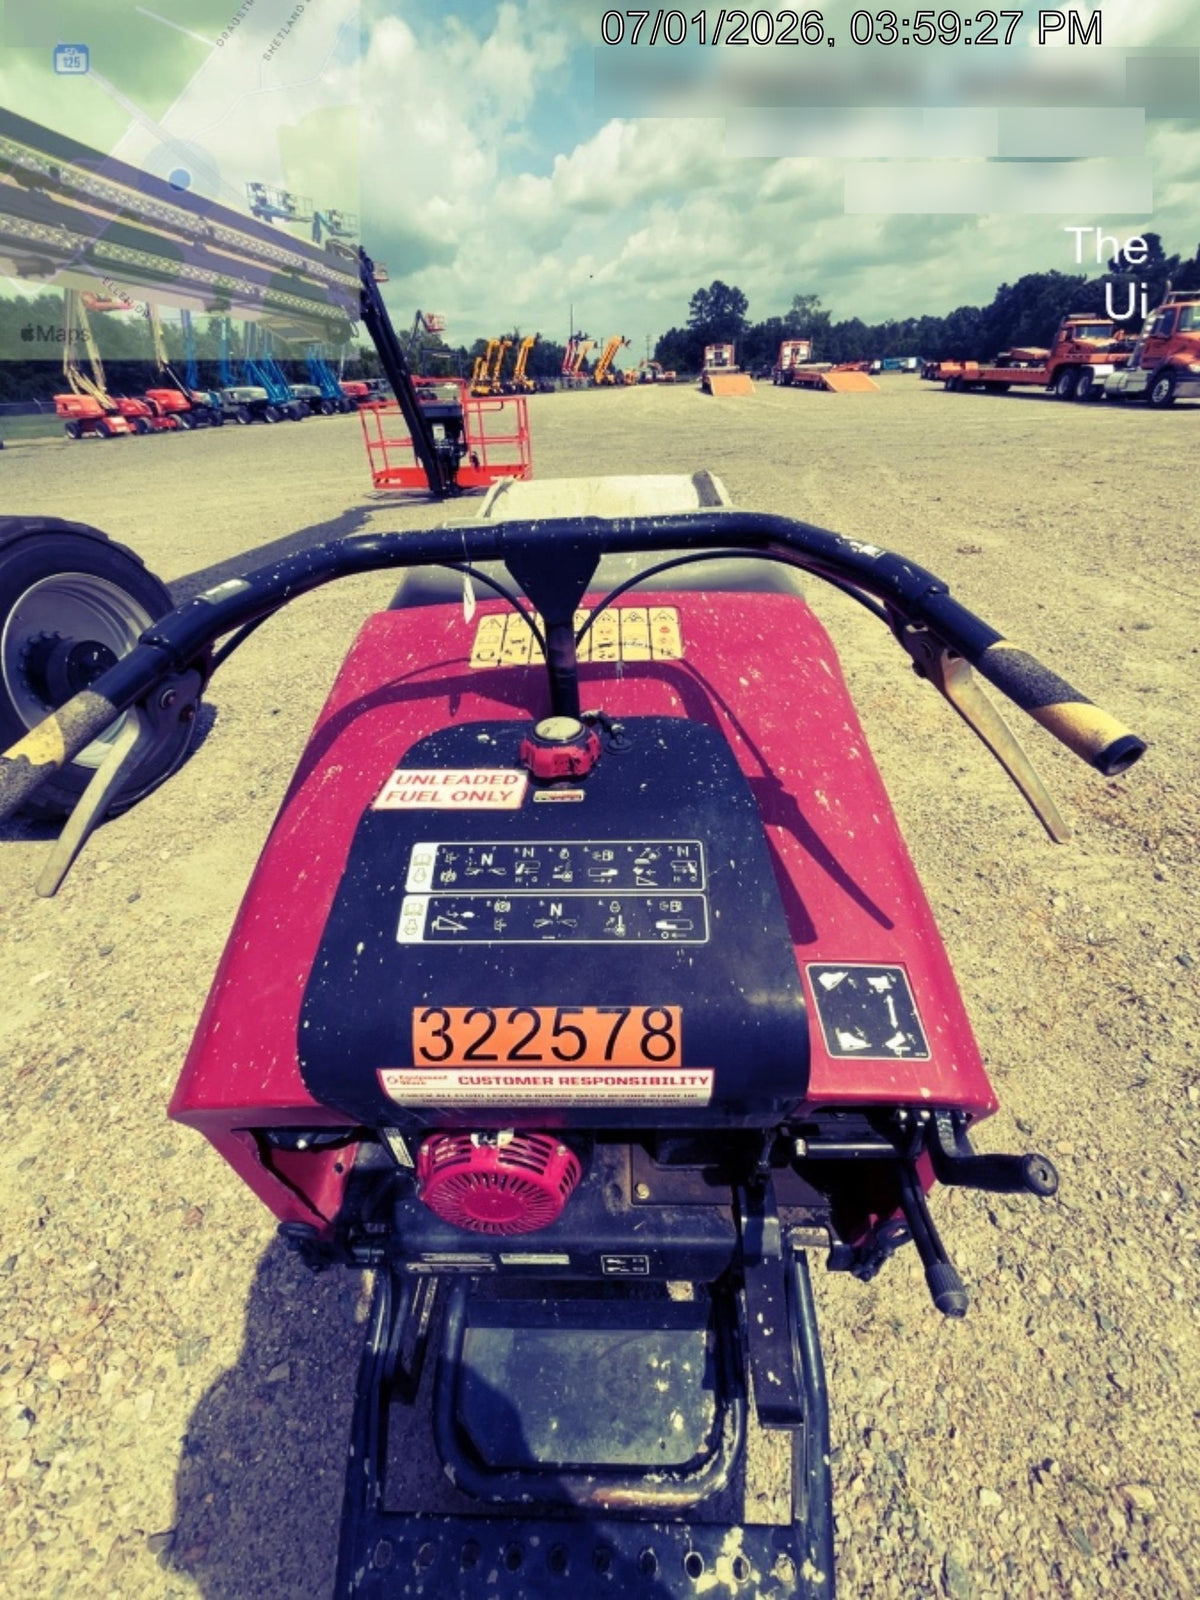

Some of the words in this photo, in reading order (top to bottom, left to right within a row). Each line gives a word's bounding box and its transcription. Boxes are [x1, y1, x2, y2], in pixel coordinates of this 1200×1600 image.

[395, 774, 520, 786] UNLEADED
[385, 790, 443, 802] FUEL
[451, 790, 515, 802] ONLY
[481, 853, 494, 866] N
[549, 903, 563, 916] N
[419, 1007, 677, 1061] 322578
[458, 1076, 554, 1085] CUSTOMER
[558, 1076, 709, 1085] RESPONSIBILITY
